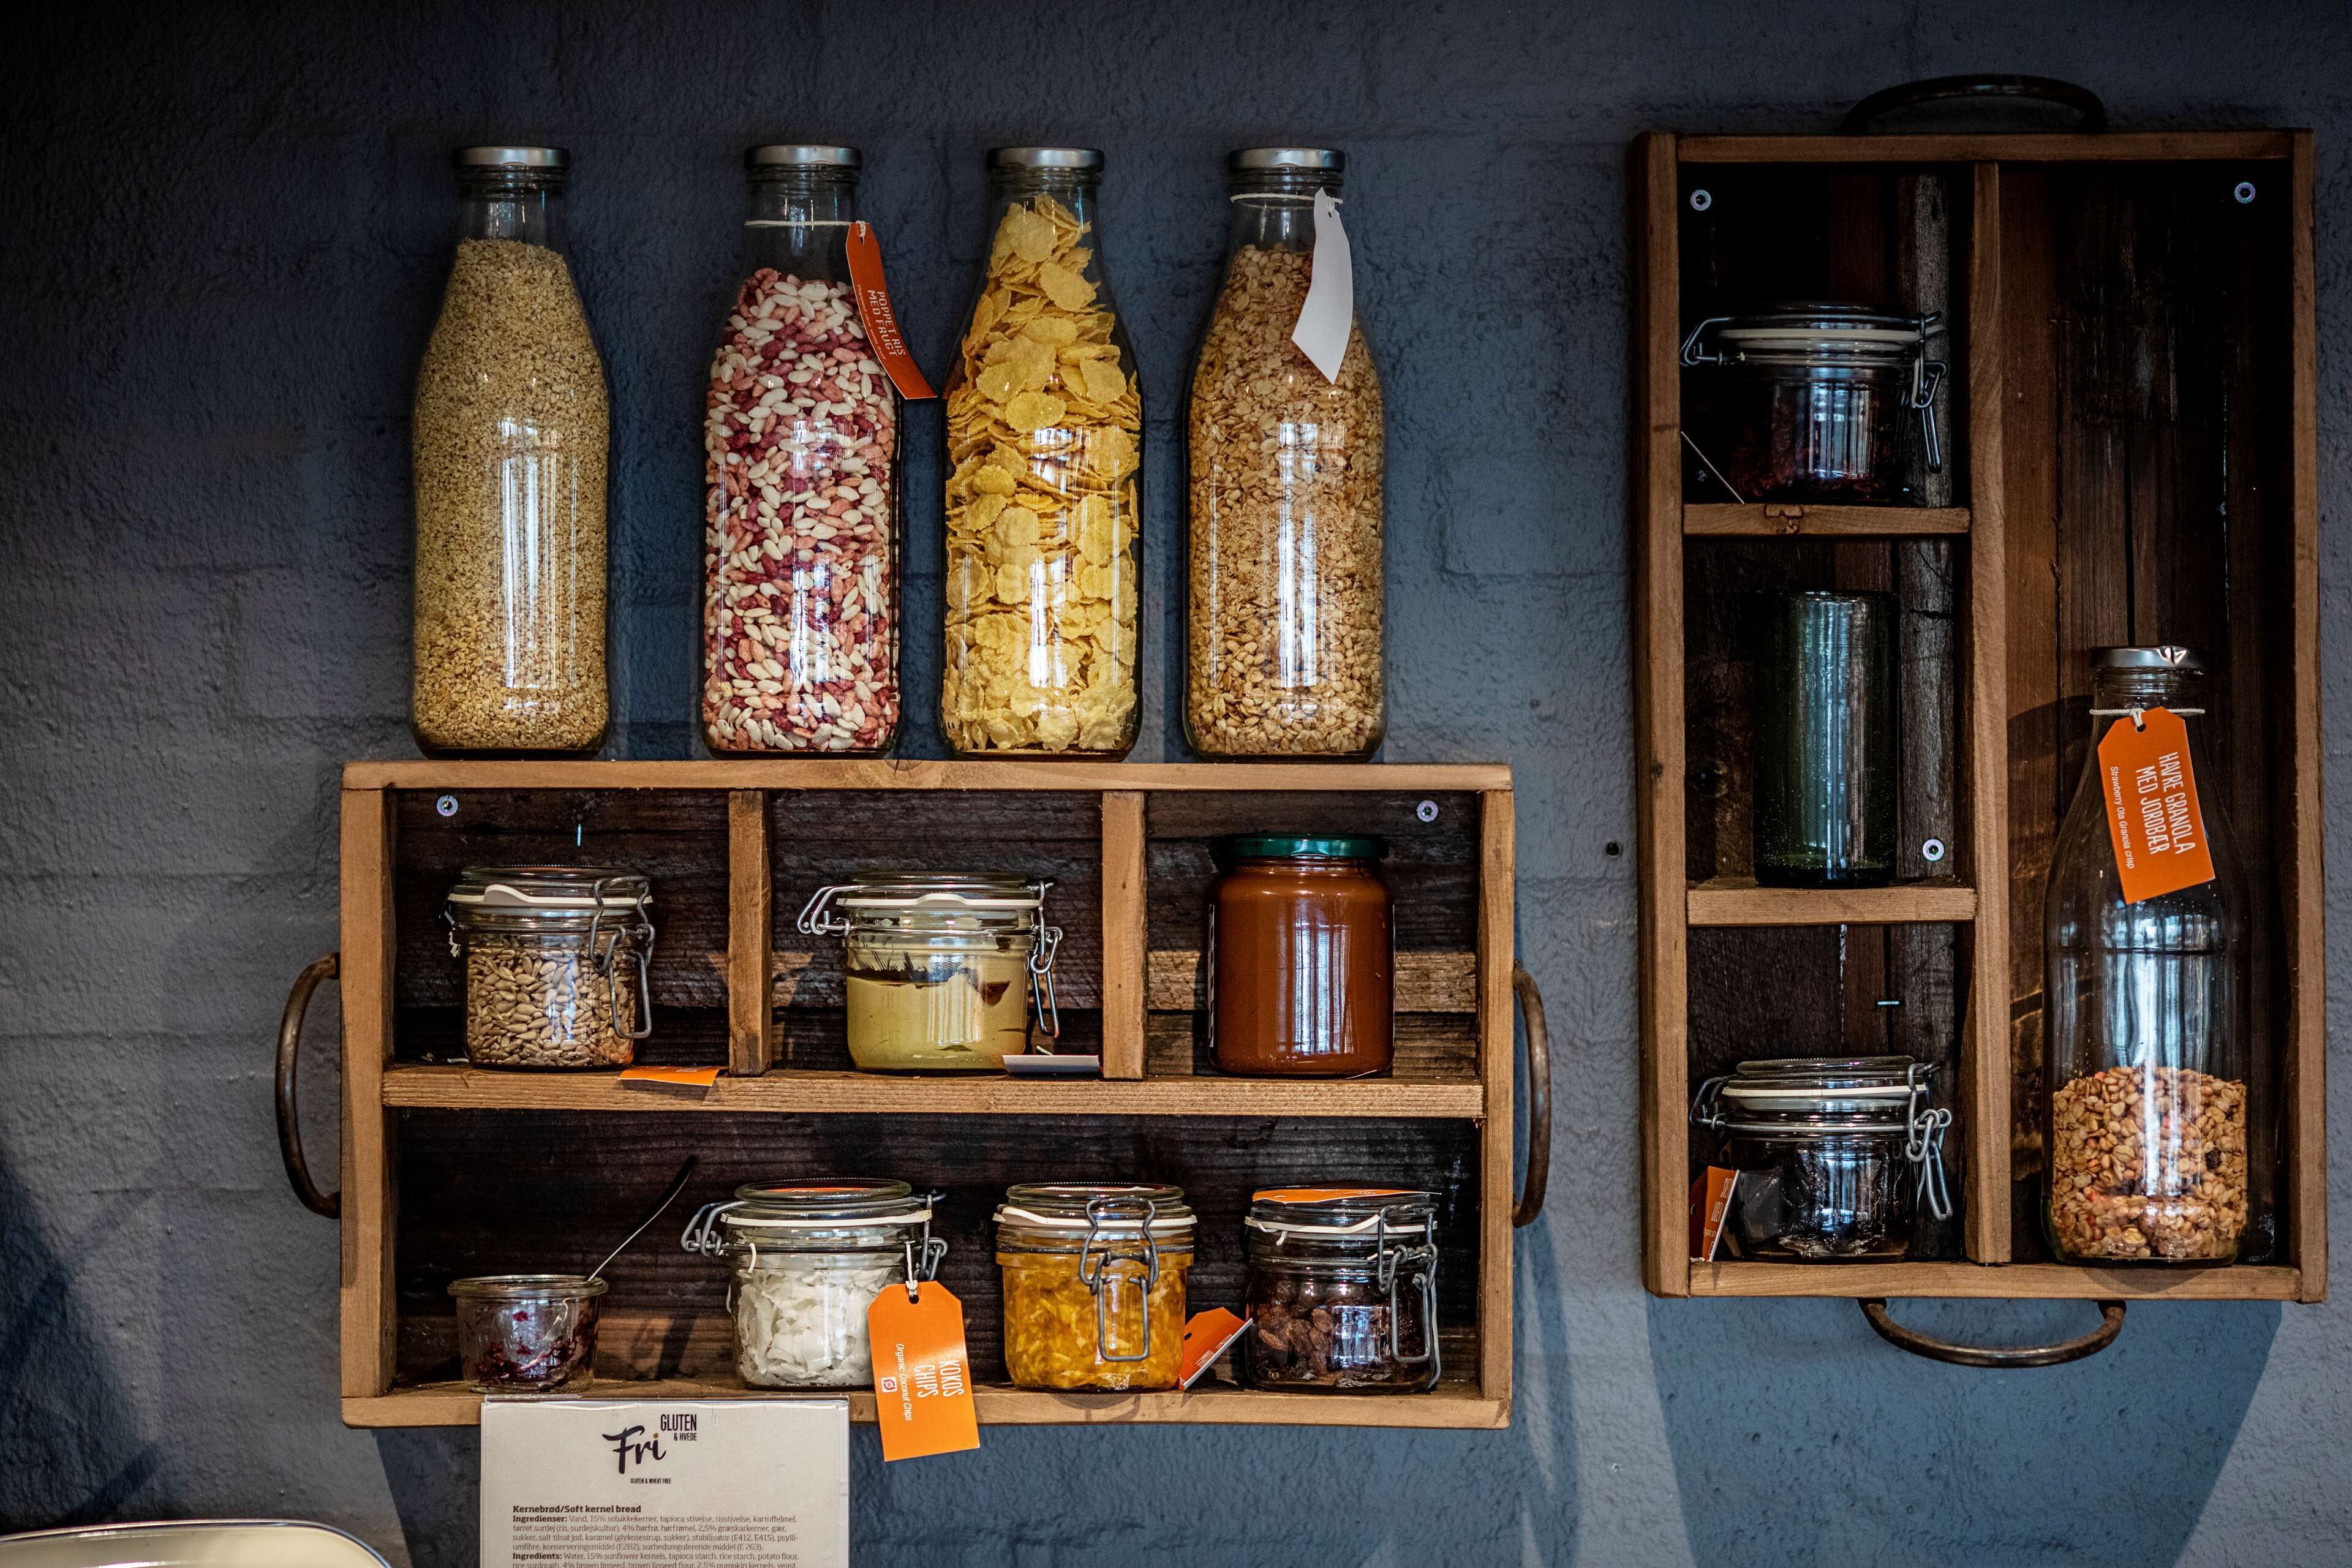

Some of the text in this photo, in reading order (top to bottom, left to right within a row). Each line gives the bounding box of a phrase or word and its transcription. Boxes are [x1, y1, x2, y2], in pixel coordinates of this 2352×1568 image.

[868, 290, 898, 356] MED FRUGT
[877, 292, 905, 355] POPPET RIS
[2111, 766, 2122, 805] Strawberry
[2119, 821, 2131, 849] Granola
[2125, 851, 2134, 869] crisp
[2136, 766, 2170, 854] MED JORDBÆR
[2158, 752, 2195, 854] HAVRE GRANOLA
[895, 1343, 912, 1421] Organic Coconut Chips
[914, 1365, 939, 1398] CHIPS
[938, 1360, 964, 1396] KOKOS
[660, 1414, 697, 1431] GLUTEN
[673, 1432, 698, 1441] & HVEDE
[602, 1425, 666, 1474] Fri
[513, 1515, 567, 1524] Ingredienser:
[660, 1515, 684, 1524] tapioca
[533, 1525, 555, 1533] surdej
[543, 1543, 614, 1552] konserveringsmiddel
[642, 1543, 711, 1552] surhedsregulerende
[777, 1534, 798, 1543] psylli-
[513, 1553, 562, 1562] Ingredients:
[669, 1553, 693, 1562] tapioca
[758, 1553, 780, 1562] potato
